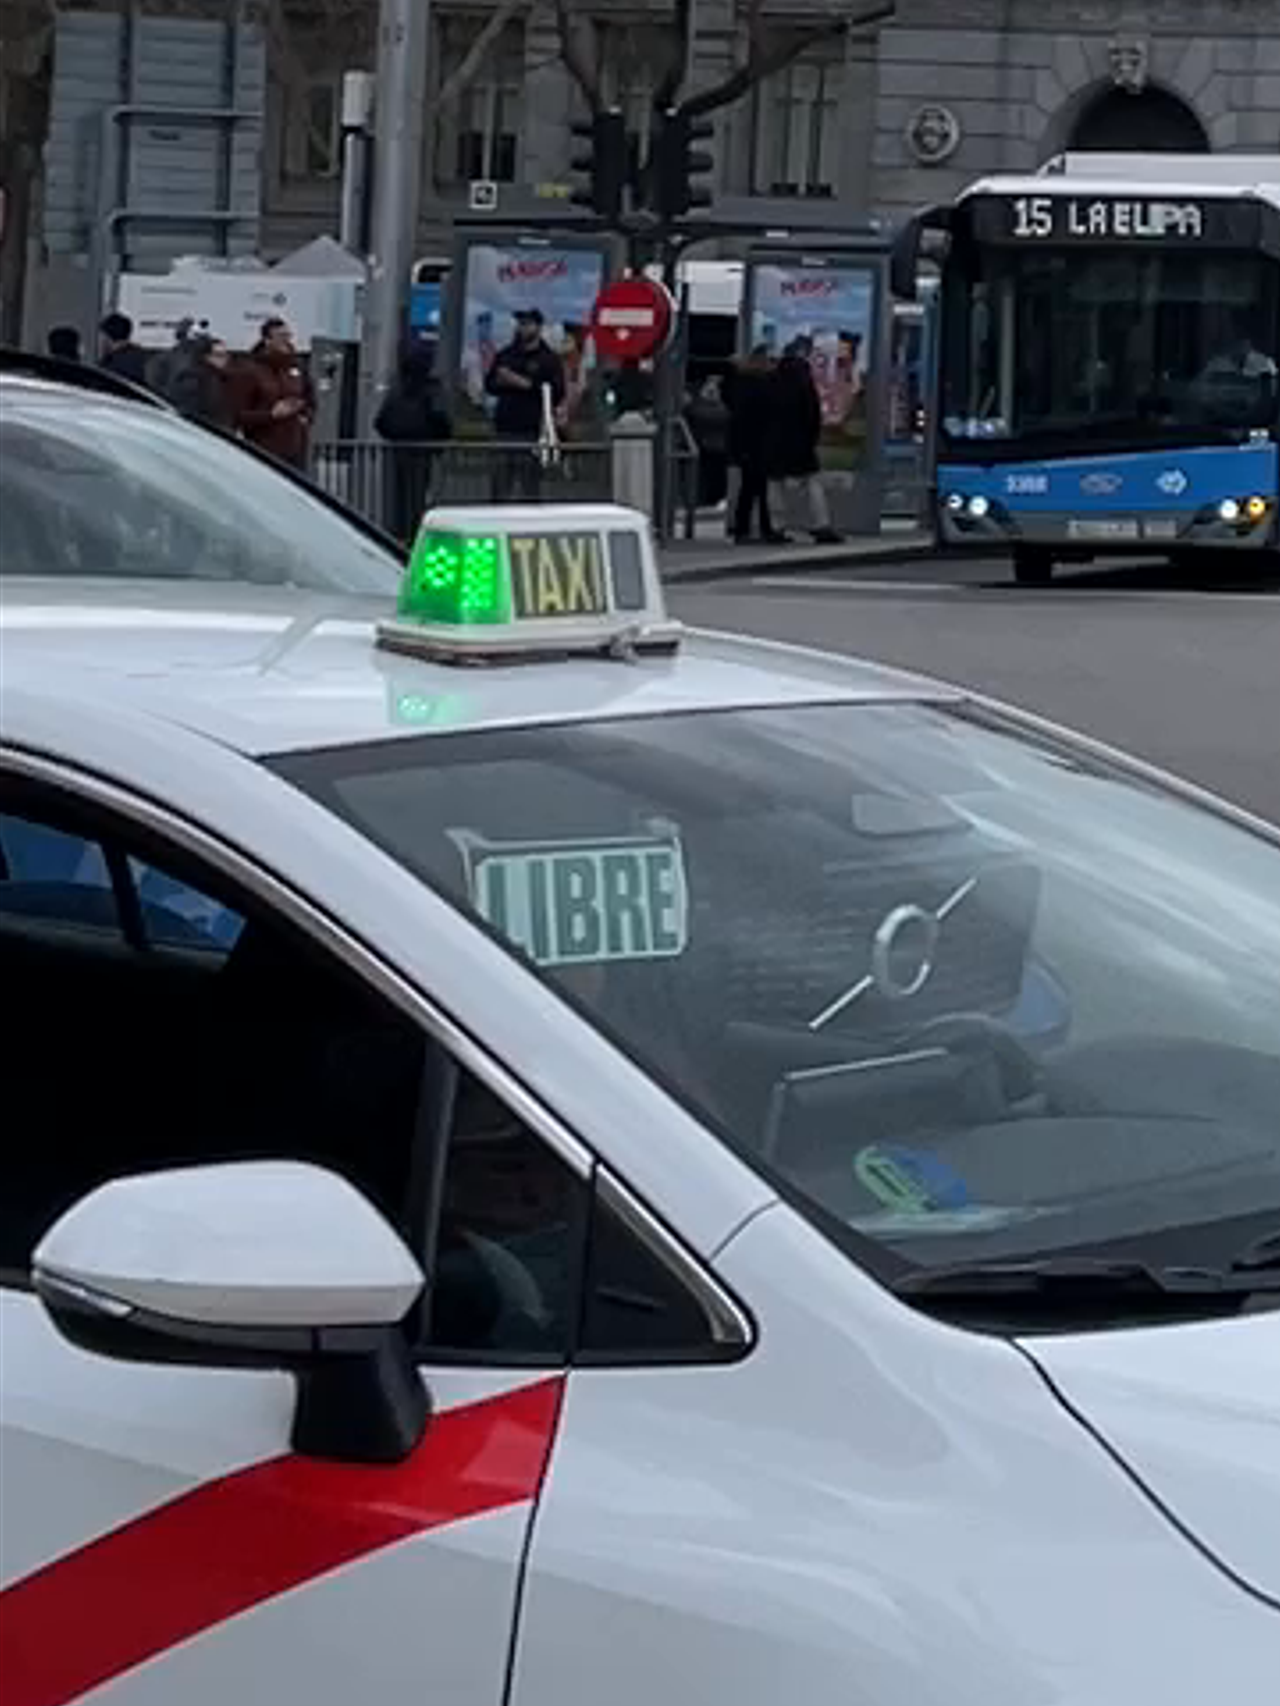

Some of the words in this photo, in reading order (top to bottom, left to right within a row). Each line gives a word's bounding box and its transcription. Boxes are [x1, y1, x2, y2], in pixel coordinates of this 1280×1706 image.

[1012, 197, 1052, 236] 15
[1067, 200, 1107, 235] LA
[512, 537, 605, 612] TAXI
[487, 853, 680, 959] LIBRE
